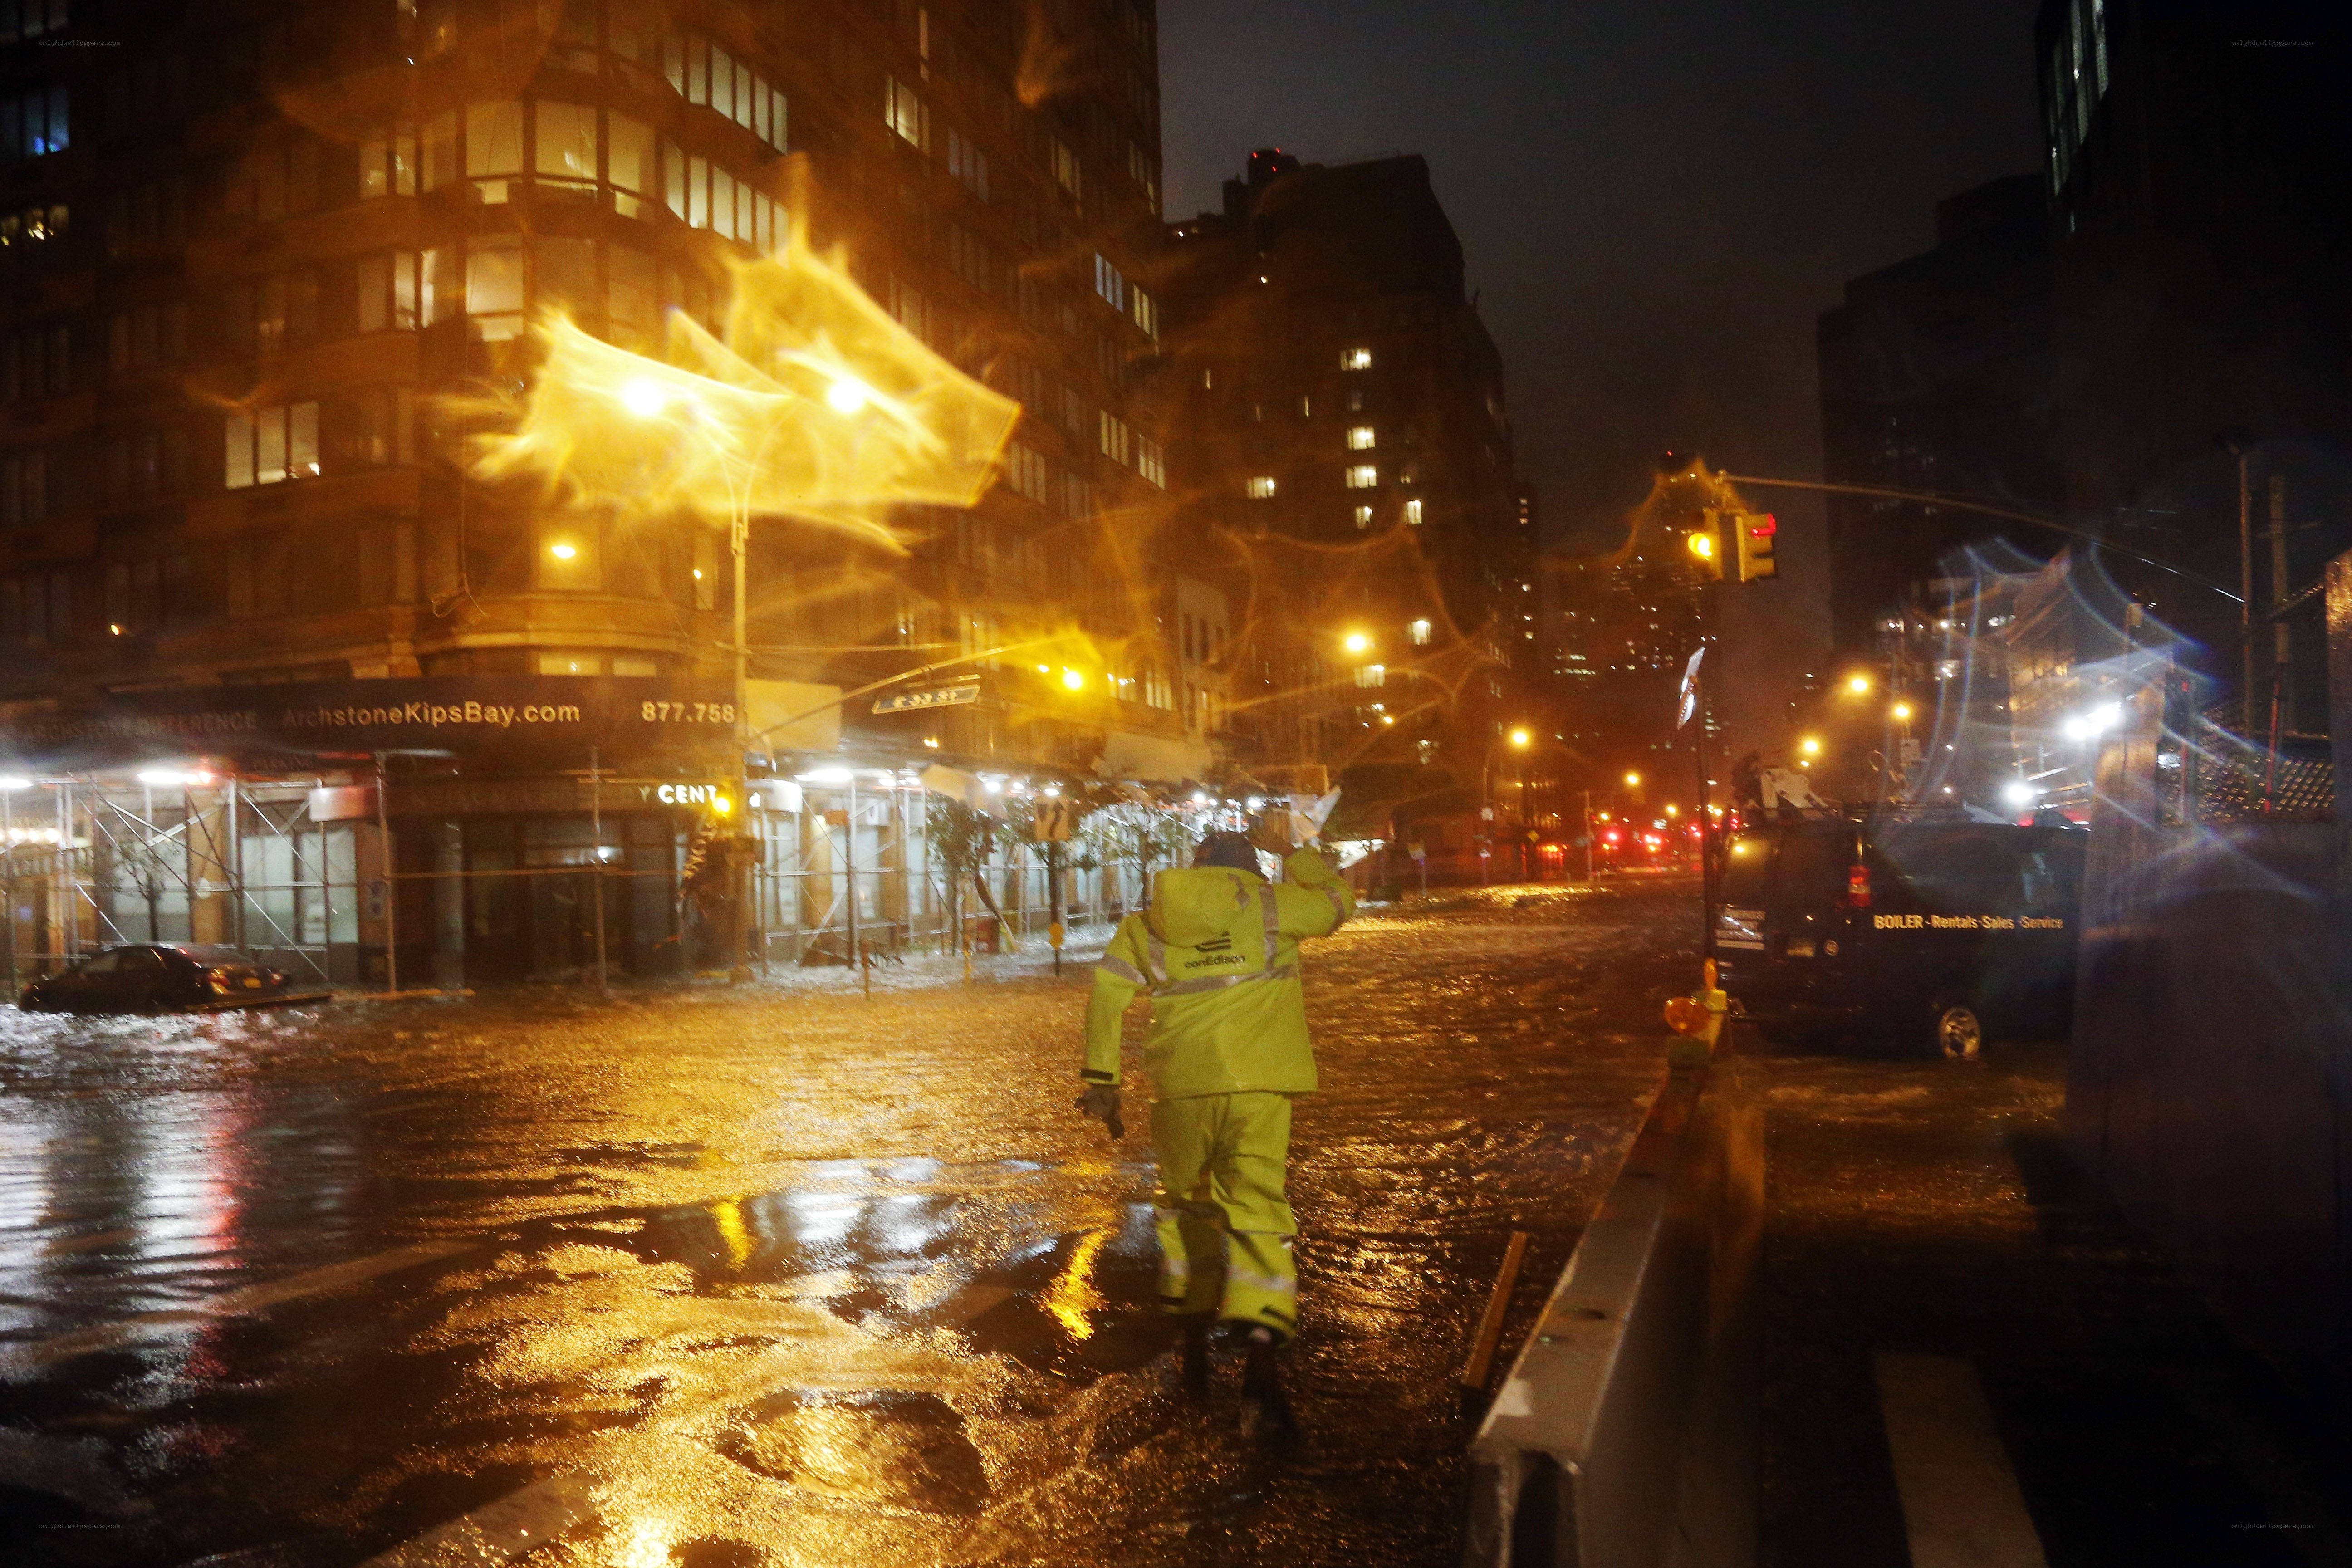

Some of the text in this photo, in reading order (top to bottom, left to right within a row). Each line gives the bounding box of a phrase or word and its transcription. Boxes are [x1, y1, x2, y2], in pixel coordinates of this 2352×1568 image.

[283, 701, 580, 727] ArchstoneKipsBay.com
[1873, 914, 2064, 929] BOILER Rentals Sales Service
